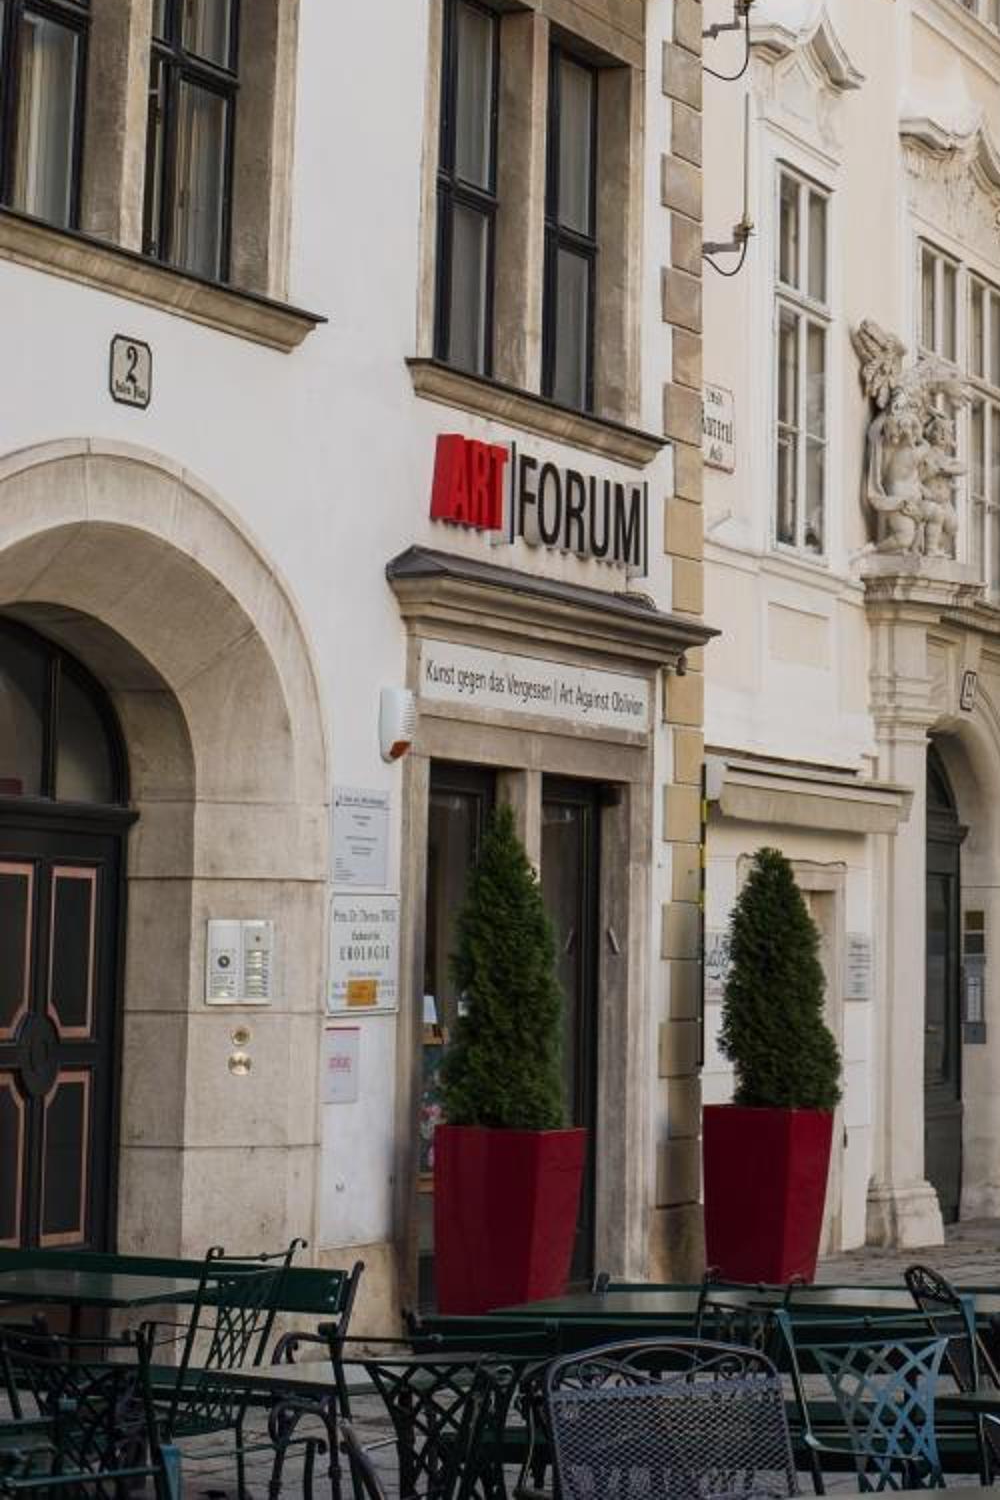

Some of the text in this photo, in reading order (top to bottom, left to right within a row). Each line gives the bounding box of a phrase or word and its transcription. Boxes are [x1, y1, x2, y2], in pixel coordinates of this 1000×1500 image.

[126, 345, 138, 384] 2
[430, 434, 641, 567] ART FORUM
[425, 659, 644, 717] Kunst gegen das Vergessen Art Against Oblivion
